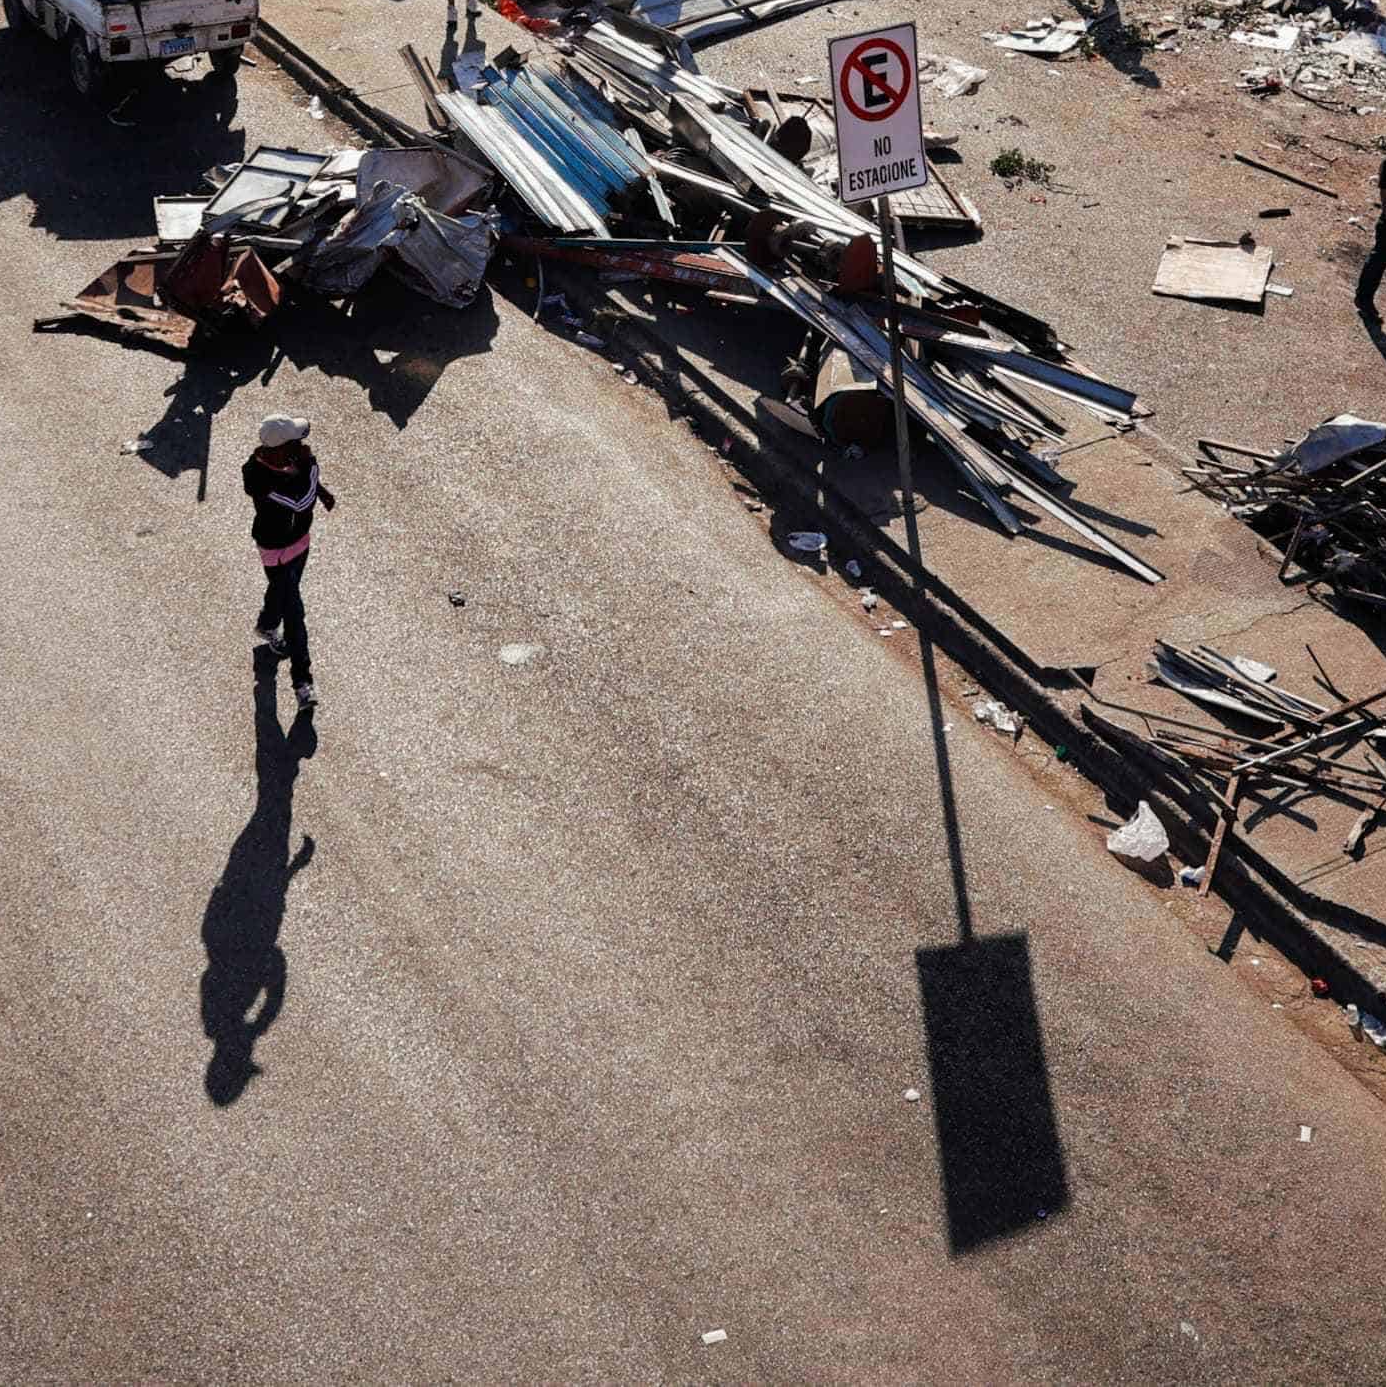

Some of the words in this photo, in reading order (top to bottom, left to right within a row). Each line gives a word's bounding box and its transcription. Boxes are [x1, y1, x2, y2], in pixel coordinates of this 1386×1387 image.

[861, 52, 891, 108] E
[873, 135, 891, 157] NO
[849, 158, 918, 192] ESTACIONE
